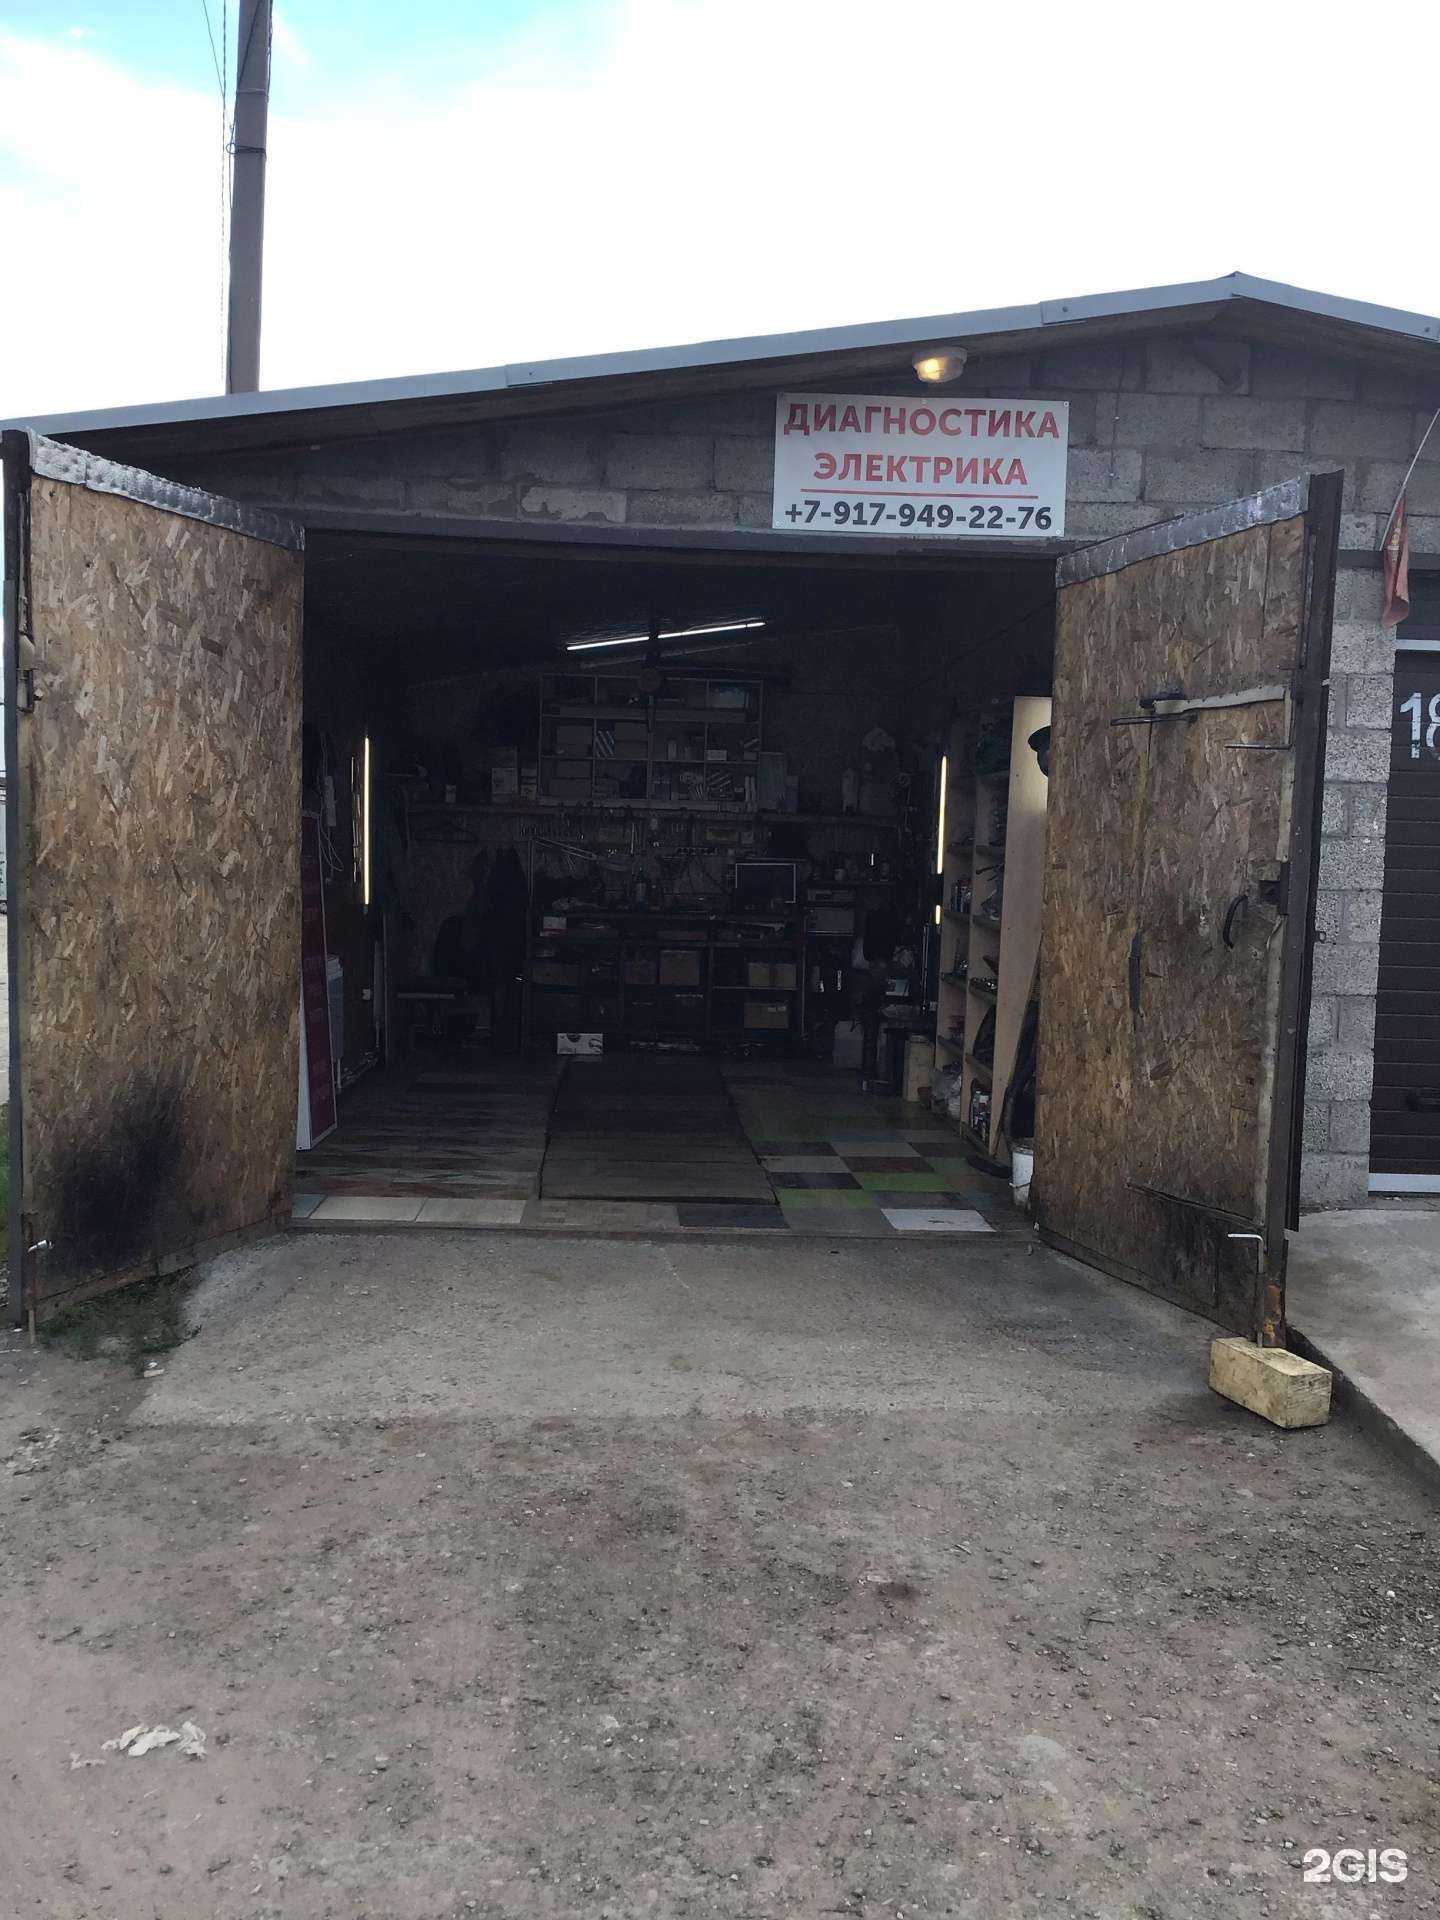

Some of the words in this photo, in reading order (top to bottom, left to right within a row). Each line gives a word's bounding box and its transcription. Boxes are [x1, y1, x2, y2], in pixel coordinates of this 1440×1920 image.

[783, 403, 1060, 438] ДИАГНОСТИКА
[813, 452, 1029, 485] ЭЛЕКТРИКА
[785, 500, 1052, 530] +7-917-949-22-76
